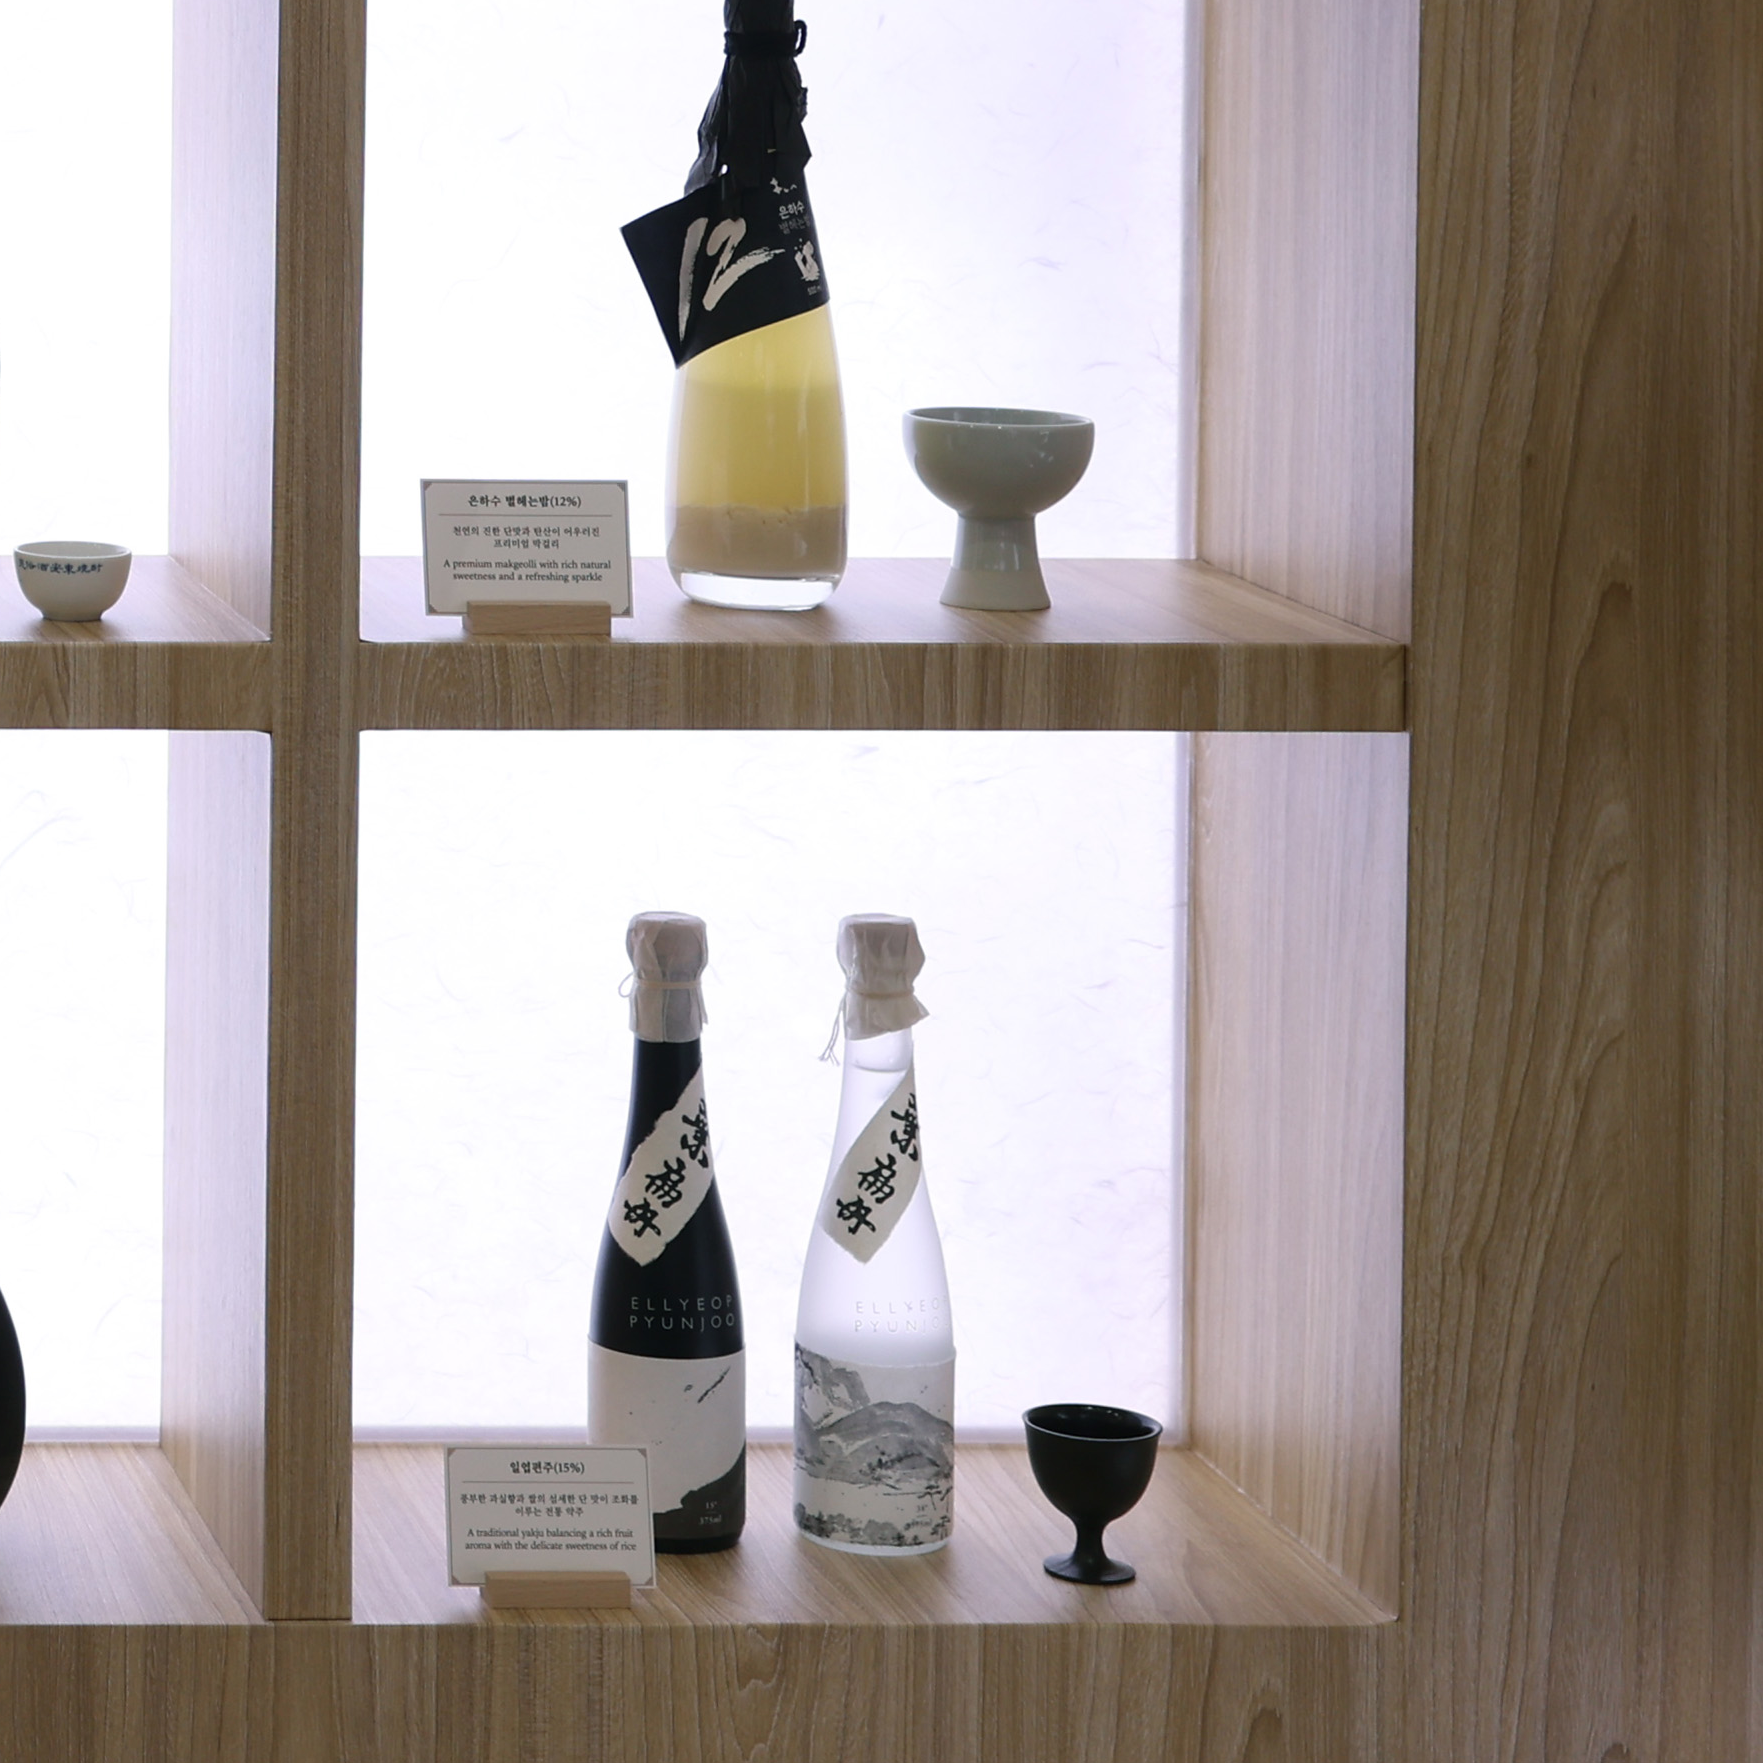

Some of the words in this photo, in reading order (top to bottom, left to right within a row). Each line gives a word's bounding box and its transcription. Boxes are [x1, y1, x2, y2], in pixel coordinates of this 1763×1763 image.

[778, 200, 805, 220] 은하수
[676, 216, 785, 344] 12
[467, 494, 501, 507] 은하수
[452, 561, 492, 570] premium
[494, 559, 537, 571] makgeolli
[538, 559, 558, 569] with
[560, 559, 578, 569] rich
[580, 559, 611, 569] natural
[631, 1295, 733, 1312] ELLYEOP
[629, 1315, 735, 1333] PYUNJOO
